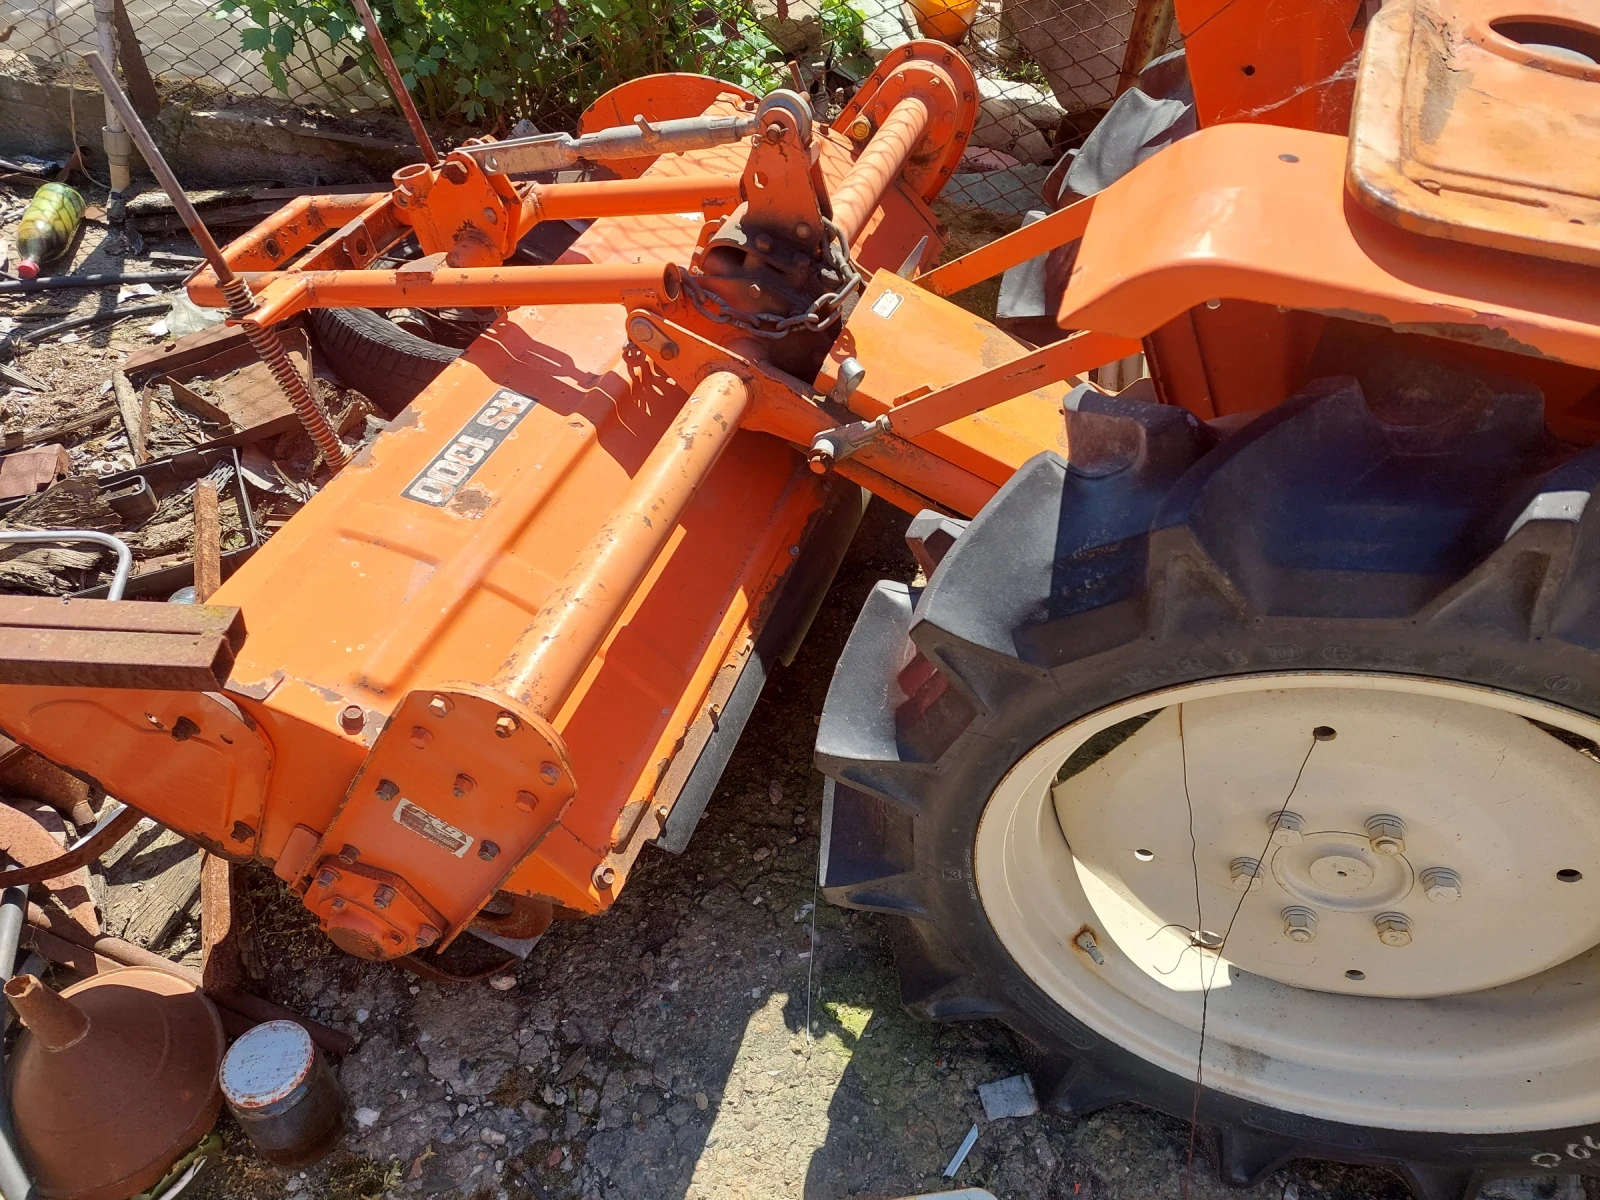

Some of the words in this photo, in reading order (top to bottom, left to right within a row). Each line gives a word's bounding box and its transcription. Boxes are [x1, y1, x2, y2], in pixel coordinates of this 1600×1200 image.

[476, 391, 533, 430] RS
[409, 434, 494, 503] 1300
[1121, 642, 1586, 697] BRIDGESTO
